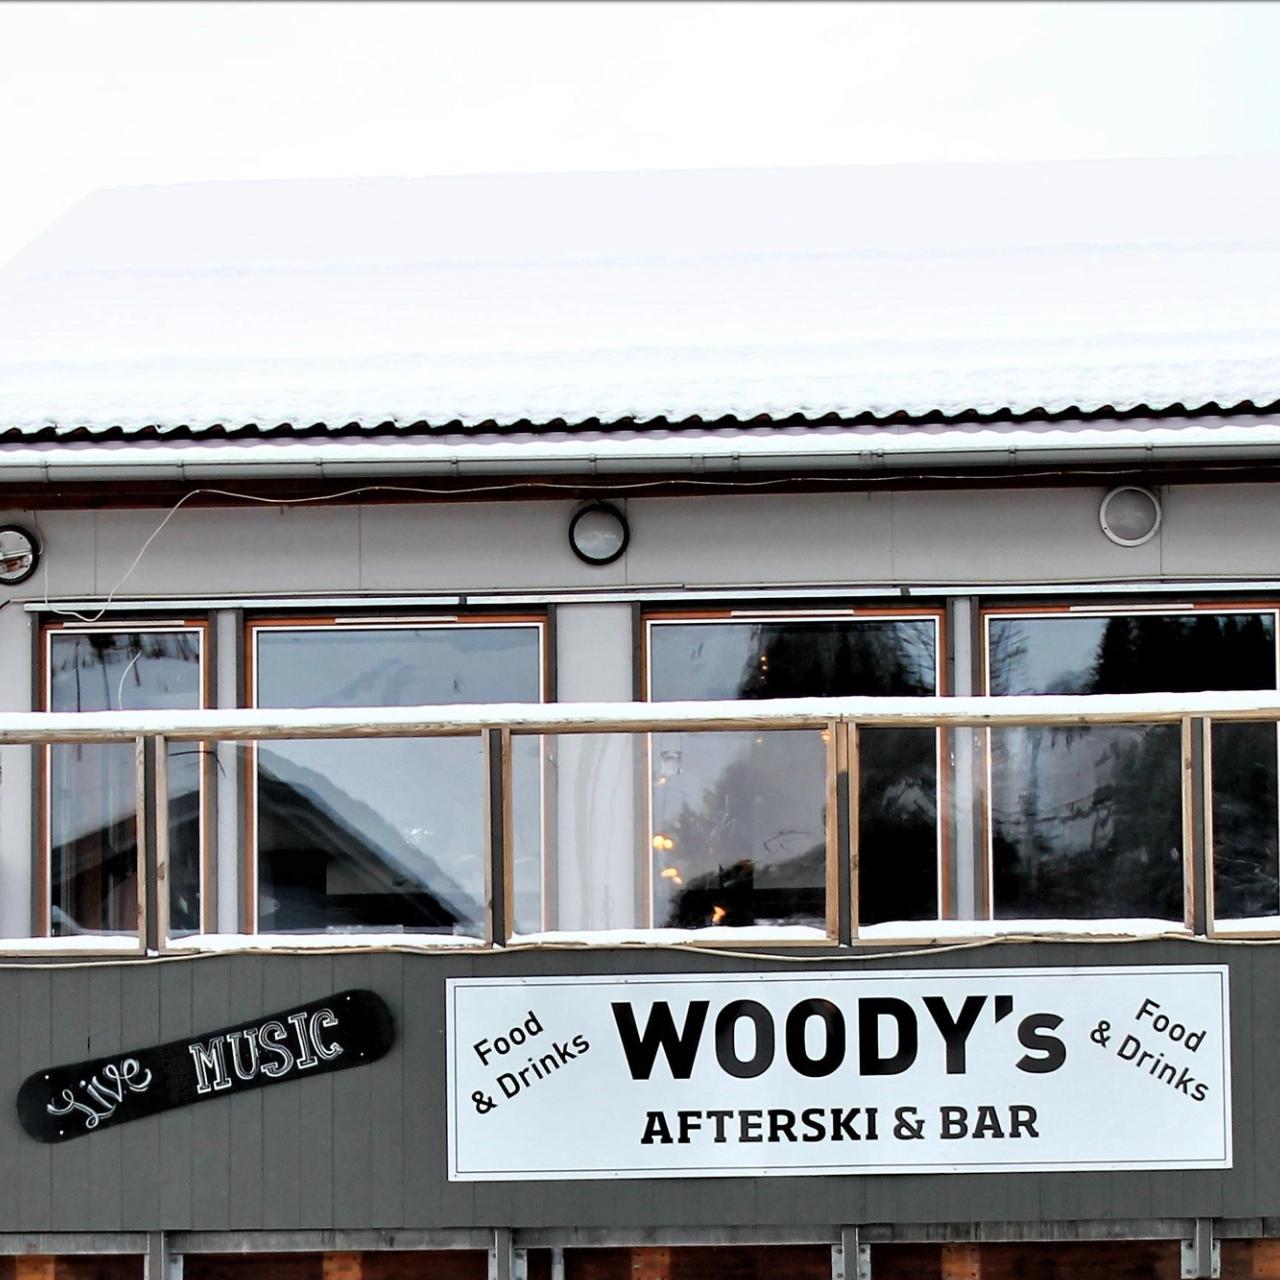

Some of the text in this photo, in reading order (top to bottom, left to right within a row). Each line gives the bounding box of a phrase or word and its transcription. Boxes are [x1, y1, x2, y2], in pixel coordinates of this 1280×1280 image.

[188, 1008, 345, 1095] MUSIC
[472, 1010, 544, 1067] Food
[610, 994, 1067, 1081] WOODY's
[1089, 1019, 1210, 1102] & Drinks
[1134, 997, 1208, 1053] Food
[470, 1032, 591, 1115] & Drinks
[640, 1105, 1040, 1145] AFTERSKI & BAR
